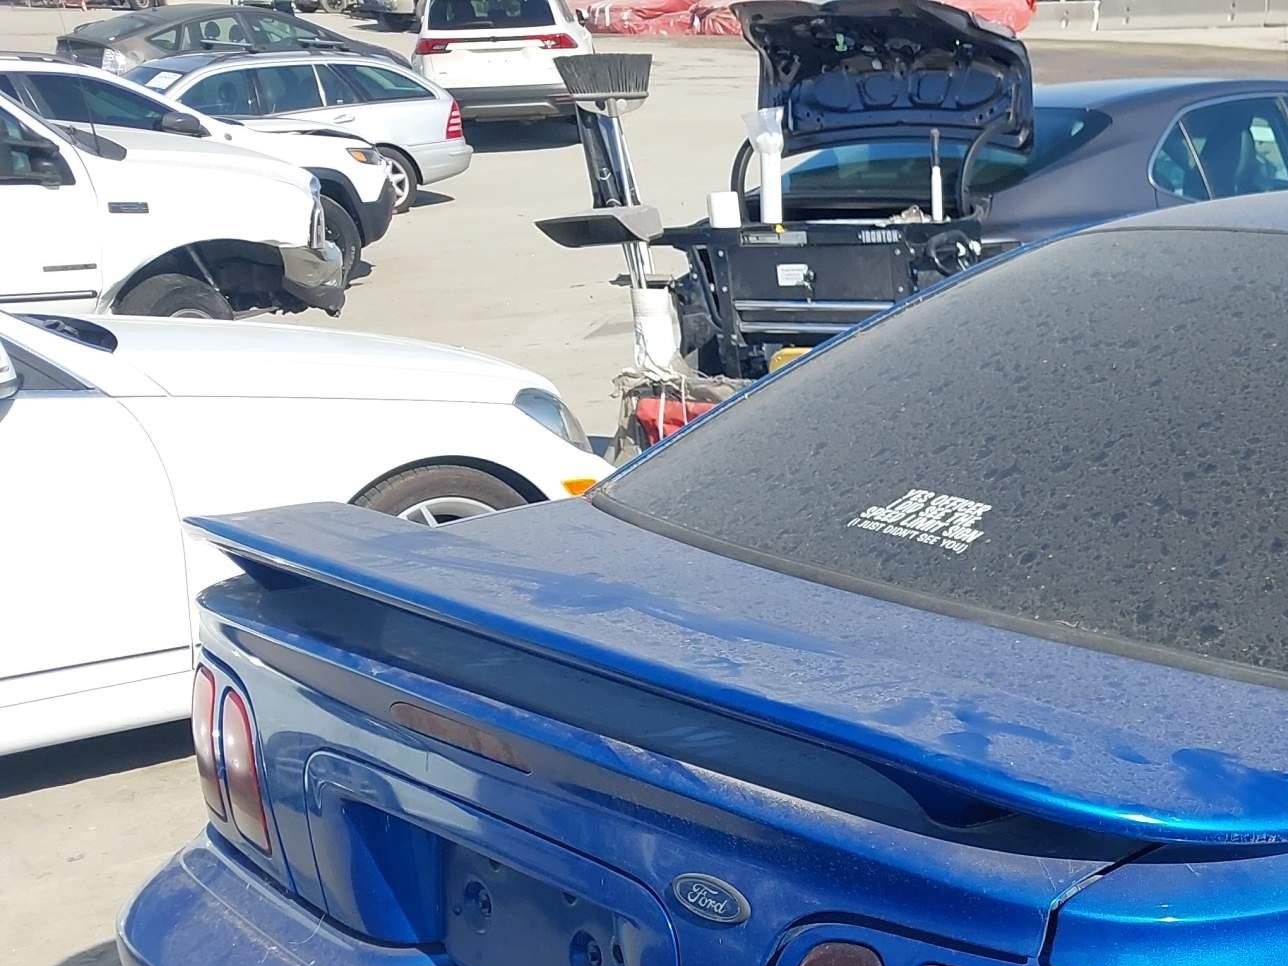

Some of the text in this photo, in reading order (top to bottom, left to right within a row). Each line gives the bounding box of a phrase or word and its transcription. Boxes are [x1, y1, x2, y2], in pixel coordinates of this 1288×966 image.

[886, 498, 983, 528] I DID SEE THE
[902, 489, 993, 517] YES OFFICER
[857, 520, 887, 533] JUST
[882, 524, 918, 540] DIDN'T
[916, 533, 941, 545] SEE
[940, 538, 969, 554] YOU)
[860, 506, 984, 544] SPEED LIMIT SIGN
[687, 883, 729, 914] Ford
